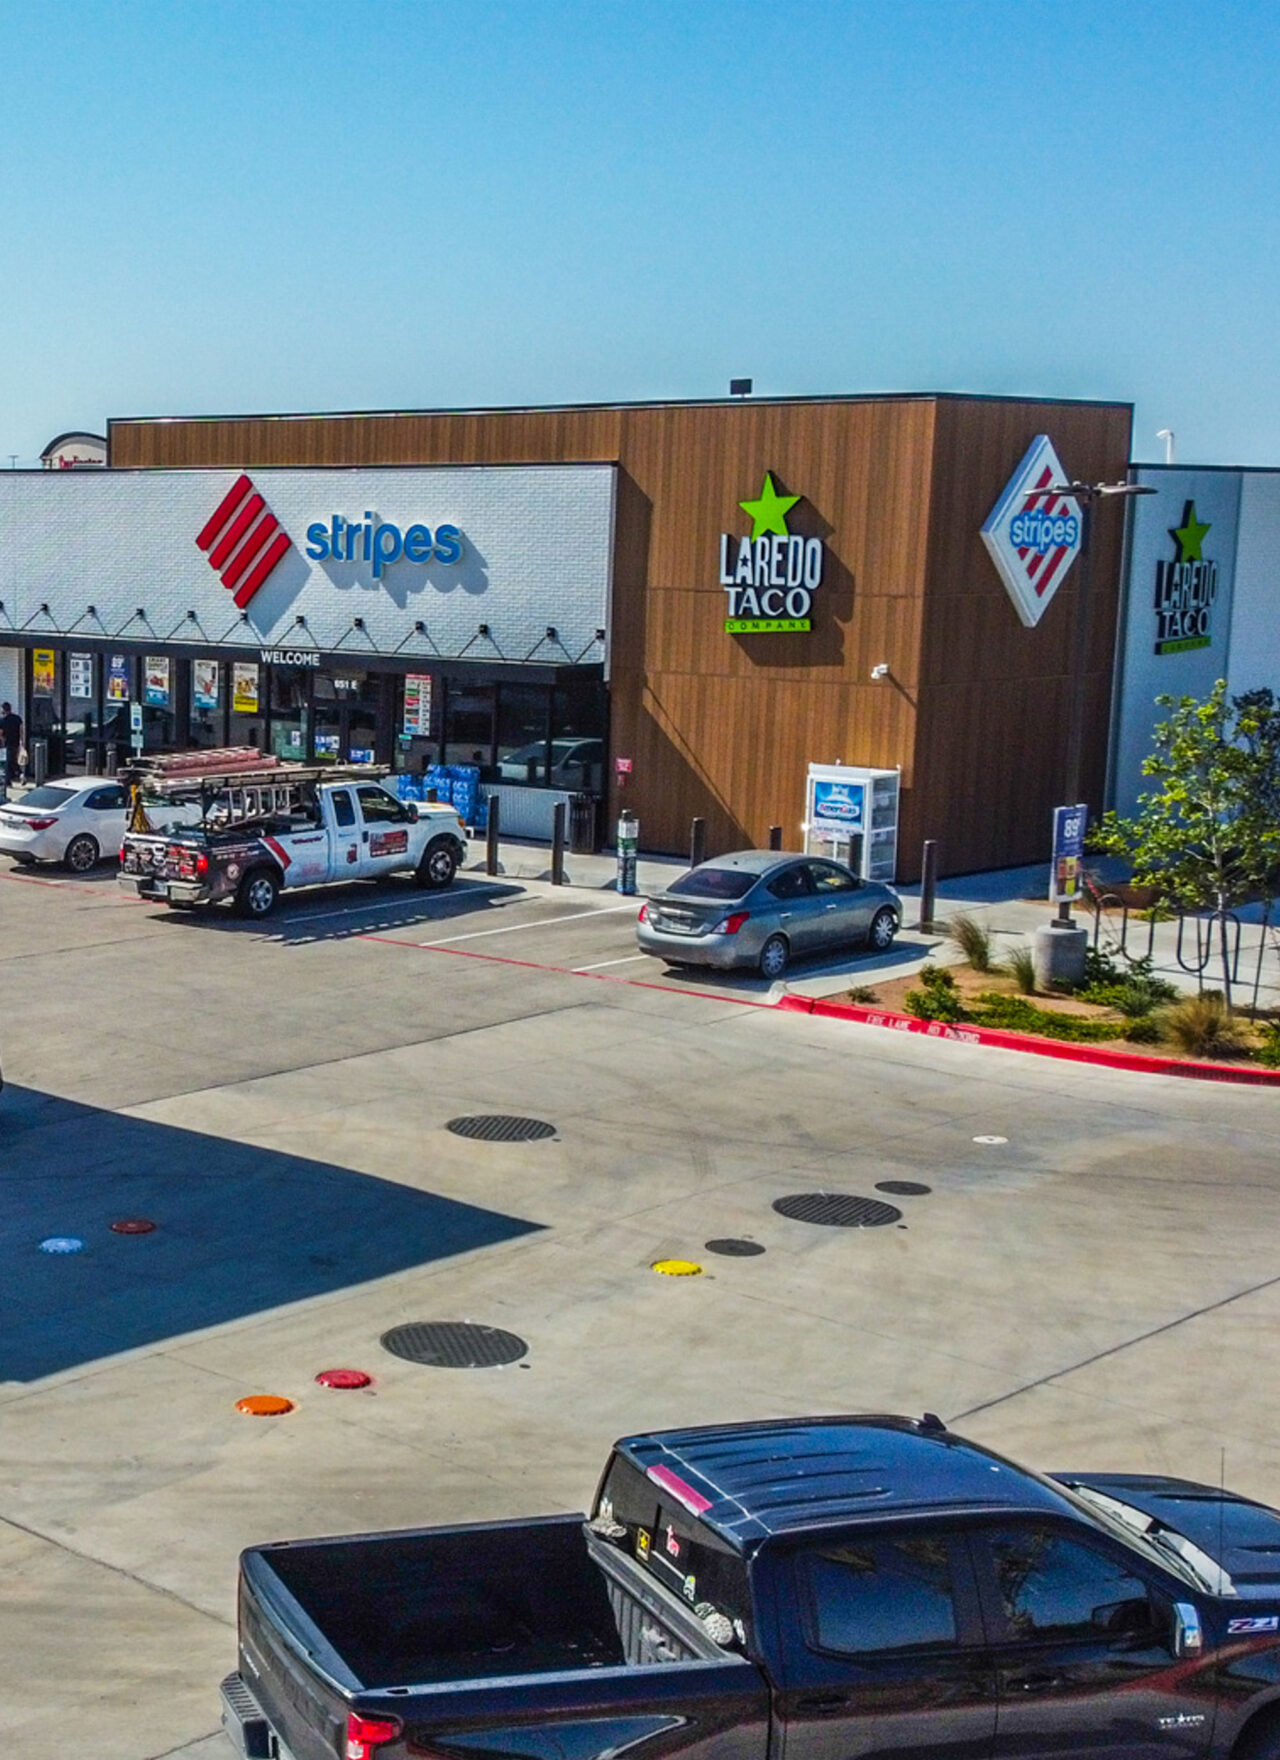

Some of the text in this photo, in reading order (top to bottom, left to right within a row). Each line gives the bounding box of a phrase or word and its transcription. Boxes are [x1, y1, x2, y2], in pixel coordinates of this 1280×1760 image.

[305, 510, 462, 578] stripes
[1010, 511, 1078, 553] stripes
[720, 533, 823, 590] LAREDO
[1157, 560, 1218, 609] LAREDO
[723, 587, 811, 618] TACO
[727, 621, 807, 631] COMPANY
[1158, 608, 1210, 639] TACO
[261, 650, 320, 666] WELCOME
[888, 1018, 911, 1032] LANE
[927, 1022, 940, 1036] NO
